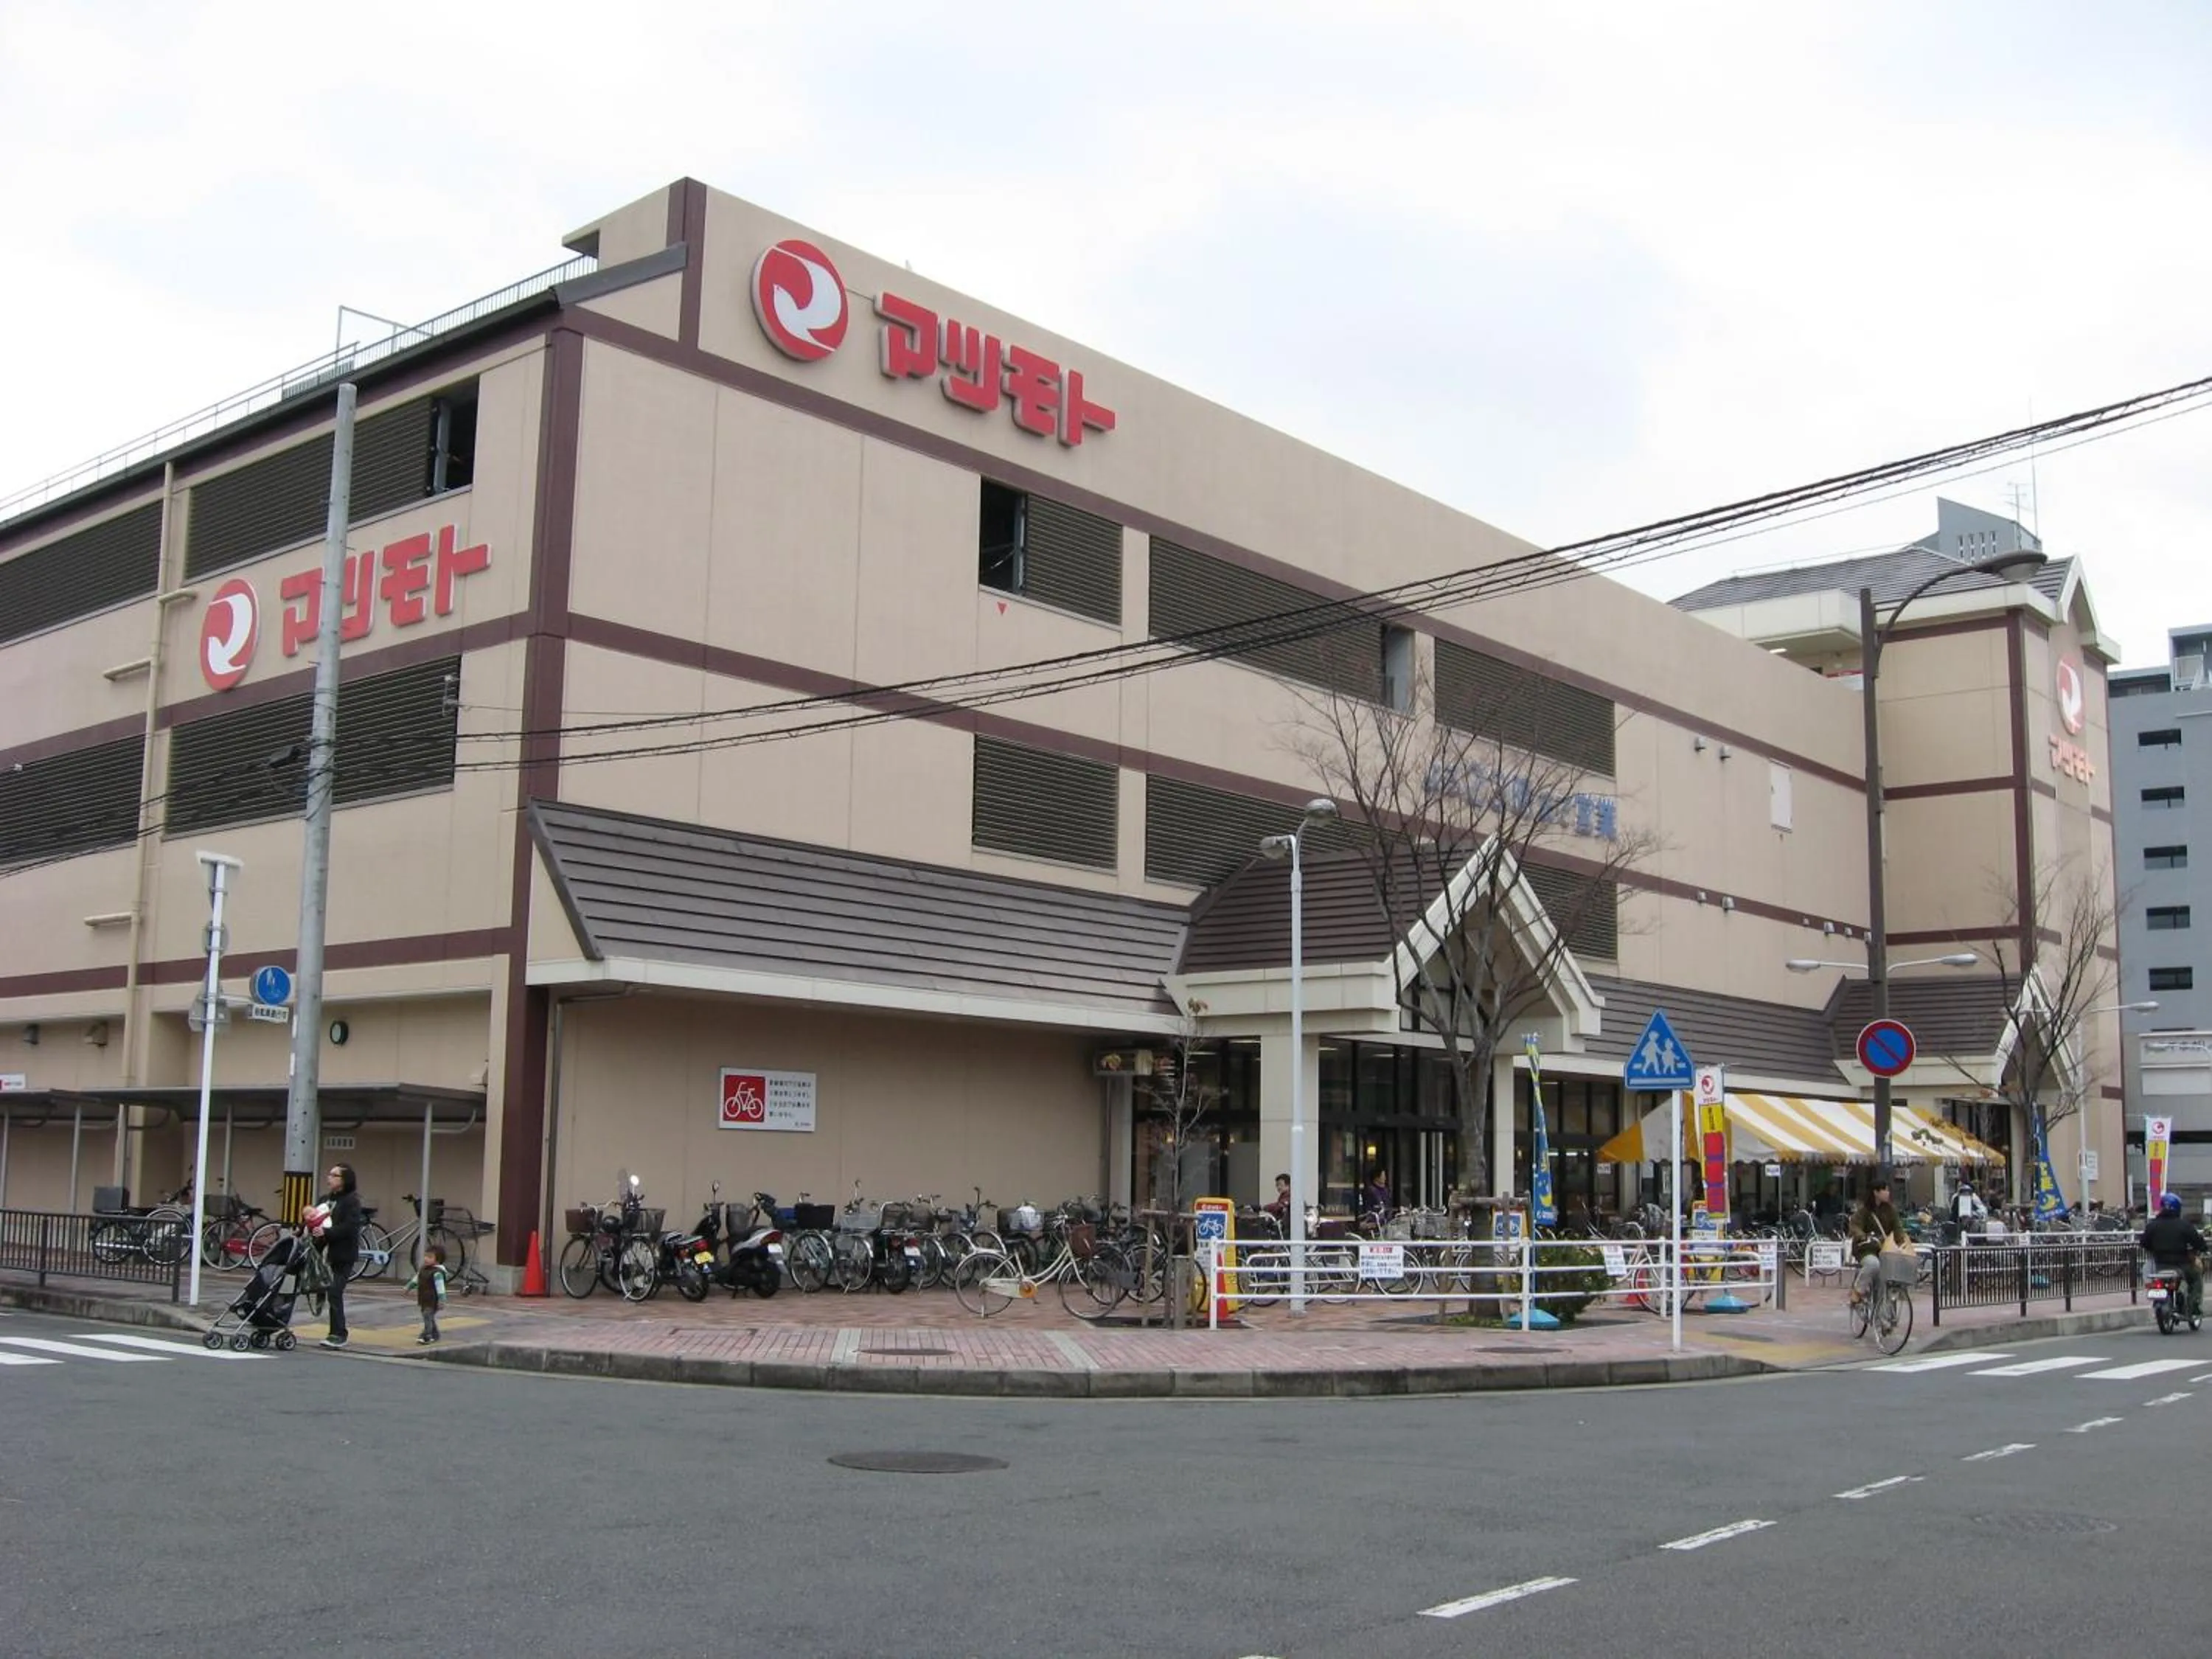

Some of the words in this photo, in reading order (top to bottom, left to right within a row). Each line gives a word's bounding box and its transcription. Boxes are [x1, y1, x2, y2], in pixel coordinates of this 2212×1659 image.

[873, 291, 1116, 448] マツモト
[2048, 734, 2095, 787] マツモト
